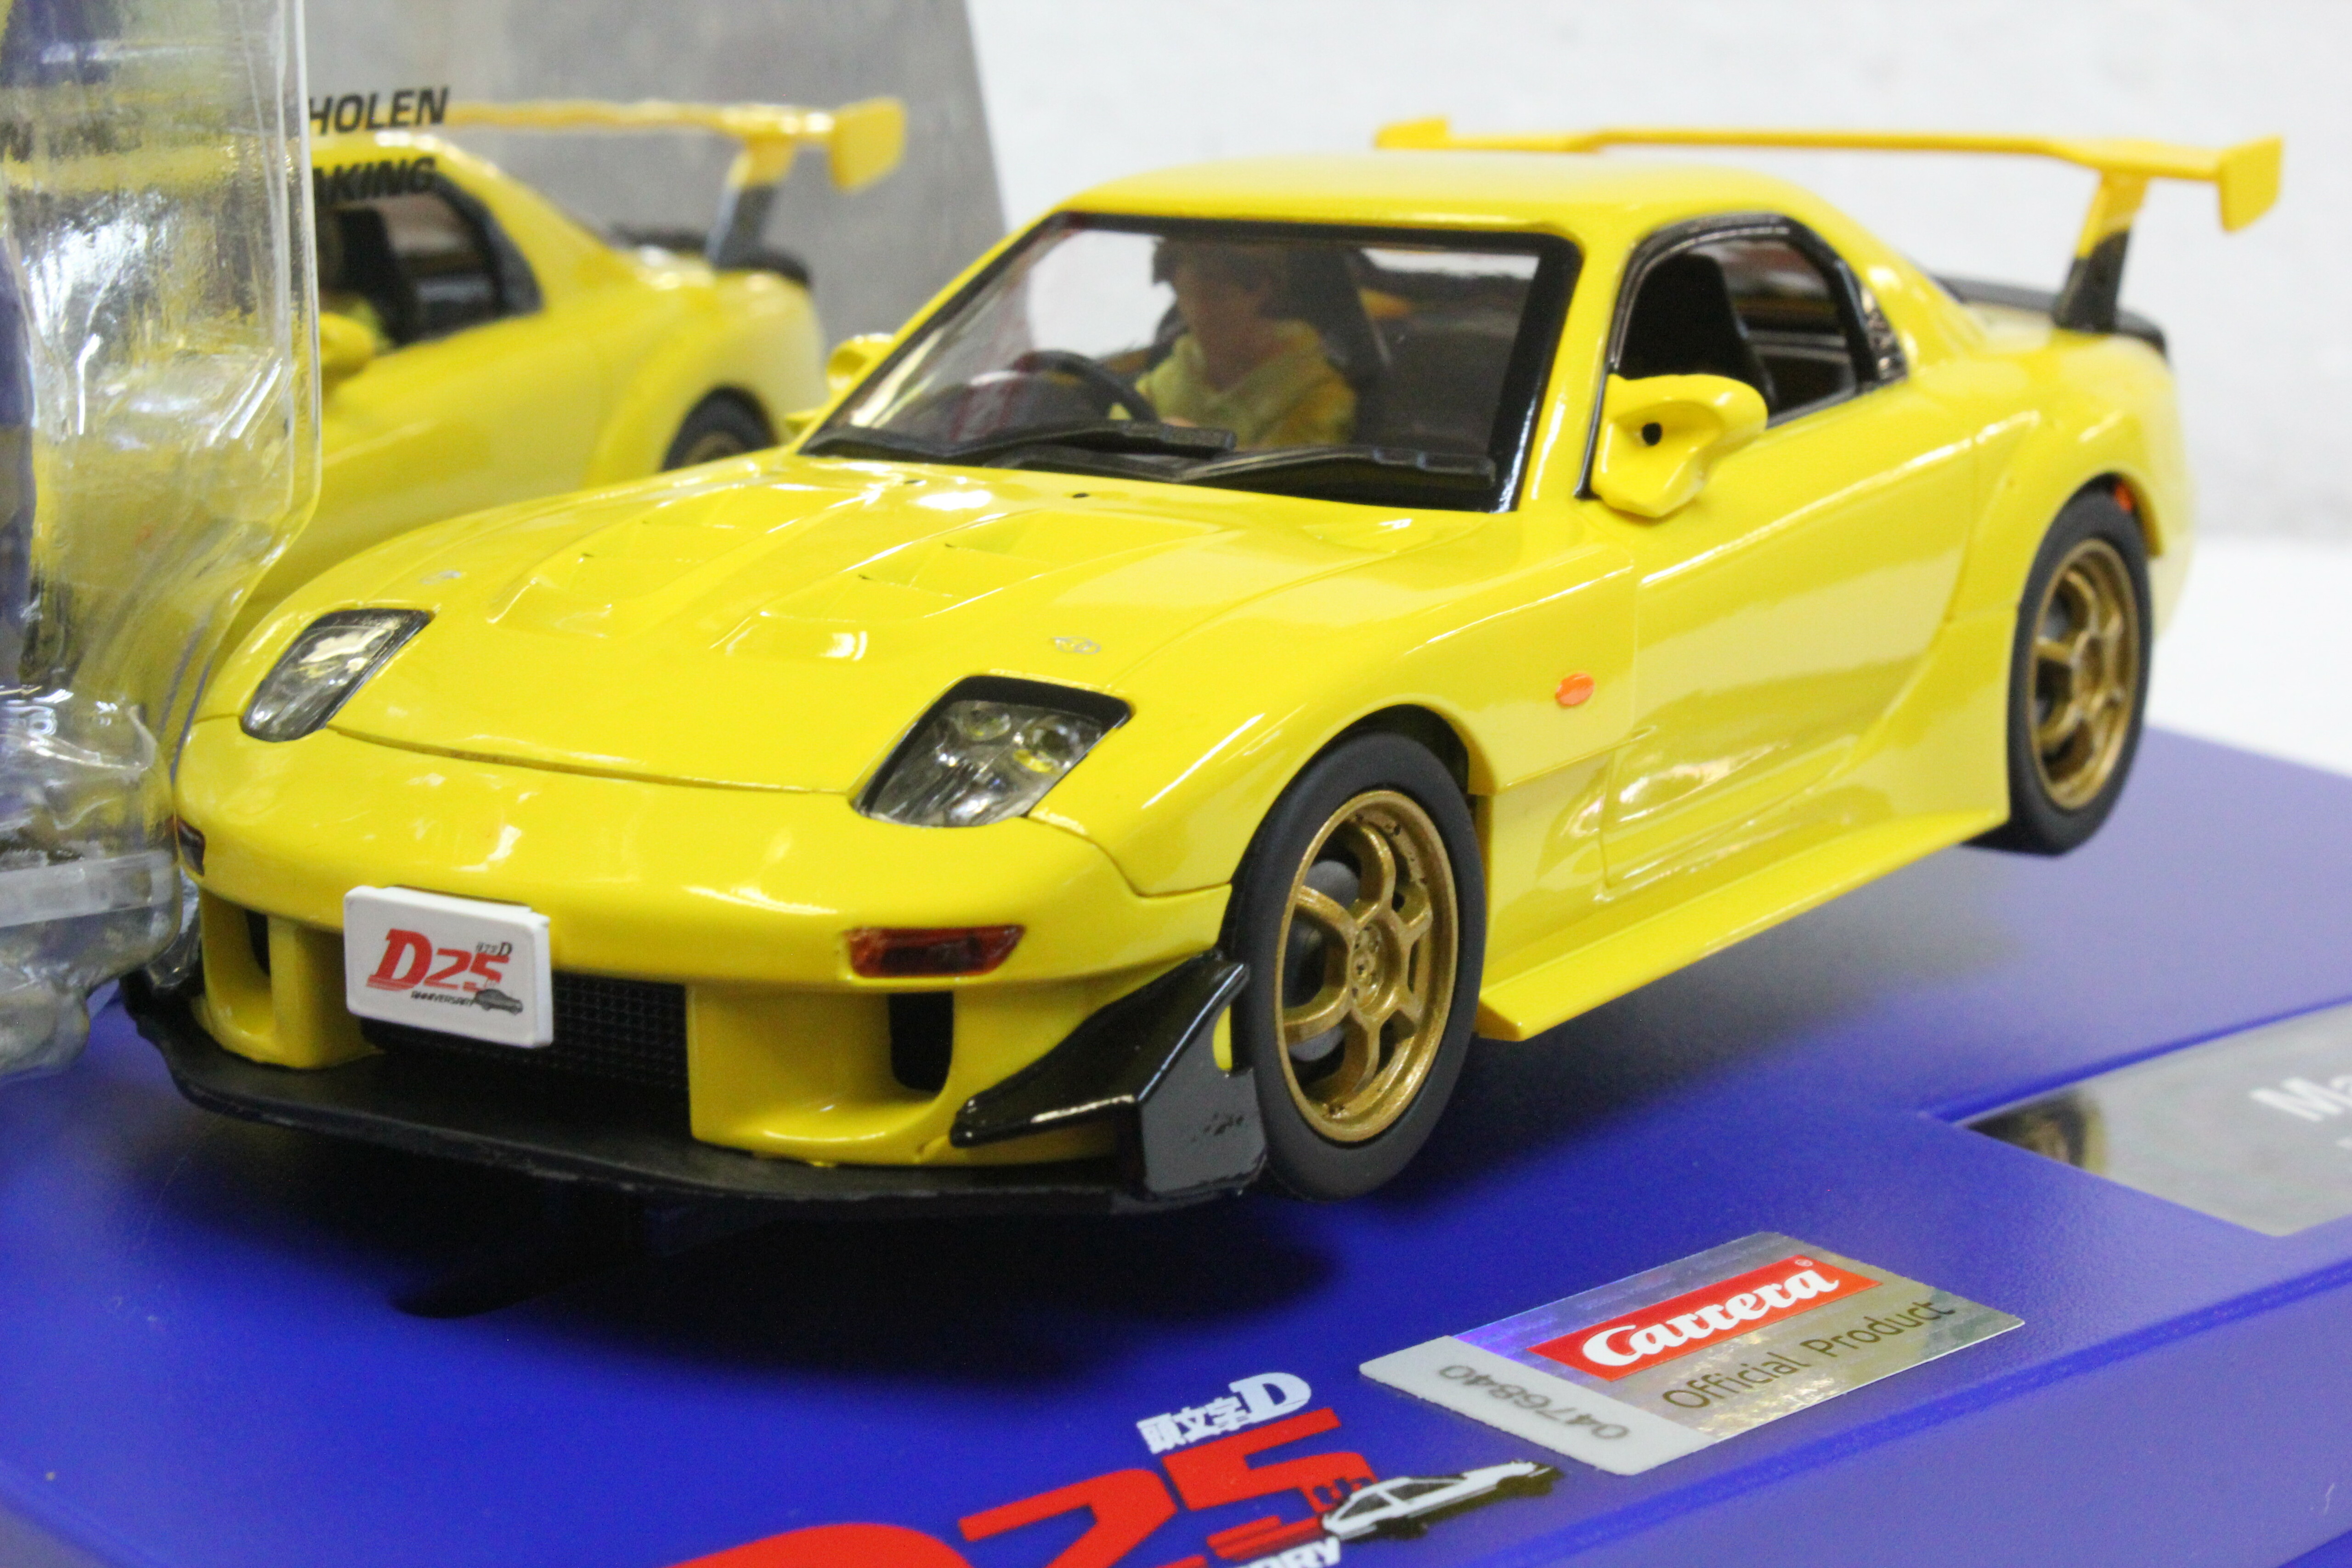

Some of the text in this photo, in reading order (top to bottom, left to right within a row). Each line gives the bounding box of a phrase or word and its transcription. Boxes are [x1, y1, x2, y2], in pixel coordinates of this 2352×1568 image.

[1583, 1270, 1839, 1366] Carrera
[1662, 1301, 1956, 1409] Official Product
